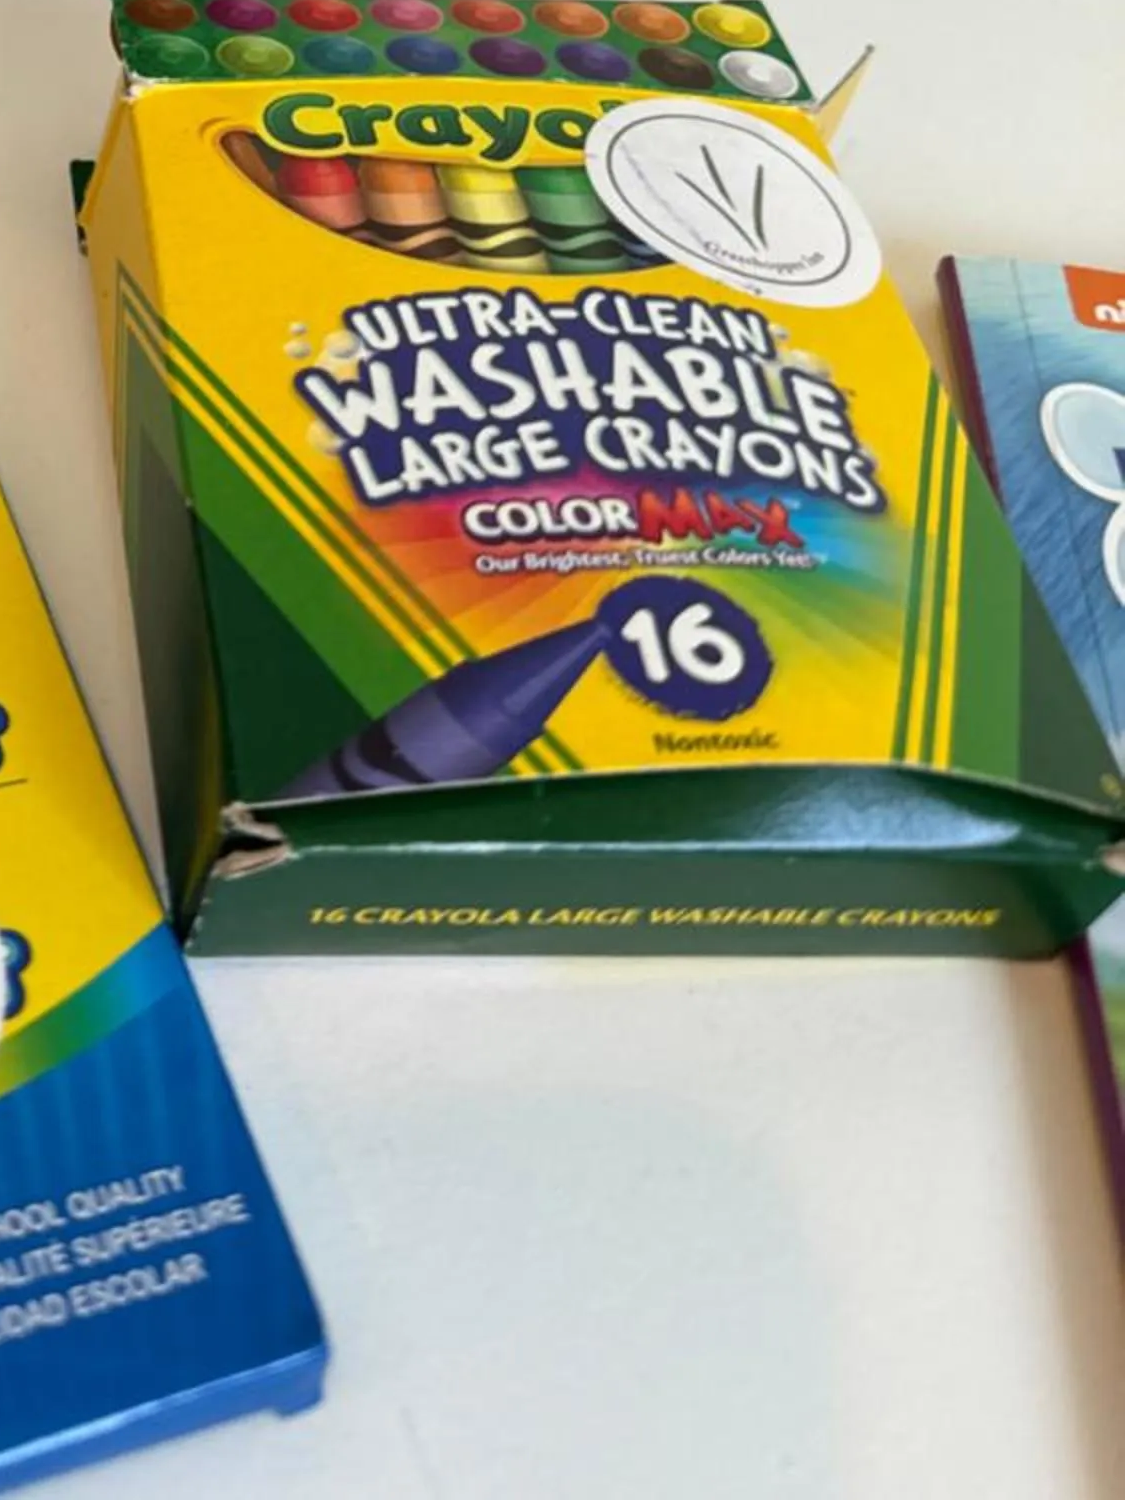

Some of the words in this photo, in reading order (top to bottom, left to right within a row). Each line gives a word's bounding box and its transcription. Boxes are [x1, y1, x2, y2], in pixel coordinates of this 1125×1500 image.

[262, 92, 625, 162] Crayo
[350, 291, 772, 358] ULTRA-CLEAN
[304, 338, 852, 451] WASHABLE
[348, 419, 571, 499] LARGE
[584, 415, 878, 508] CRAYONS
[475, 554, 520, 574] Our
[701, 546, 773, 567] Colors
[620, 601, 747, 685] 16
[652, 727, 780, 754] Nontoxic
[309, 906, 350, 925] 16
[353, 906, 521, 925] CRAYOLA
[527, 906, 642, 926] LARGE
[649, 906, 834, 926] WASHABLE
[836, 907, 1002, 926] CRAYONS
[65, 1165, 186, 1219] QUALITY
[68, 1252, 209, 1316] ESCOLAR
